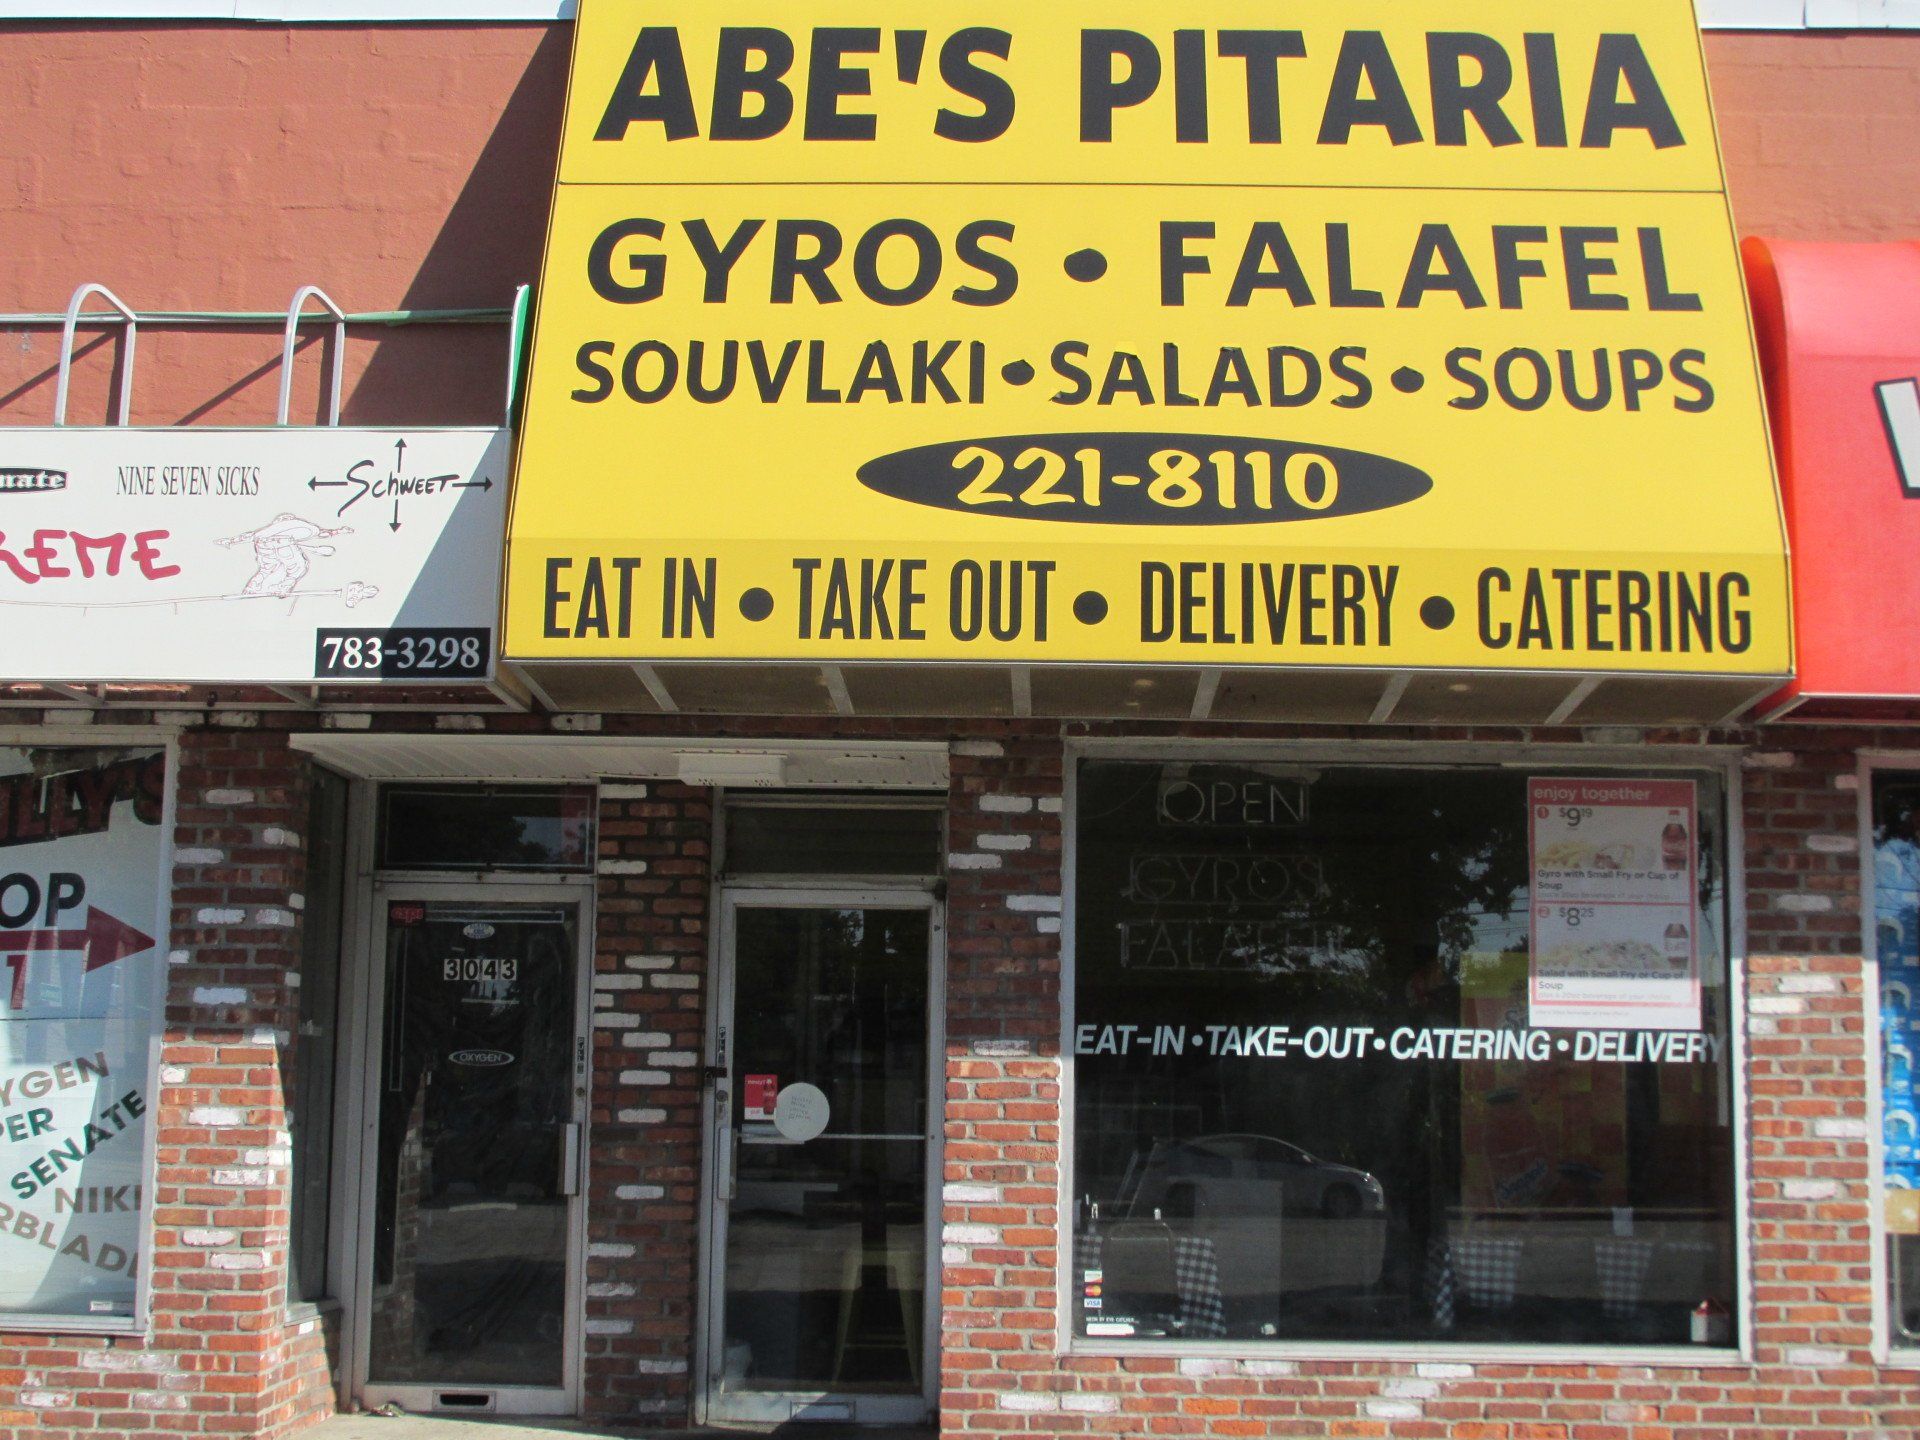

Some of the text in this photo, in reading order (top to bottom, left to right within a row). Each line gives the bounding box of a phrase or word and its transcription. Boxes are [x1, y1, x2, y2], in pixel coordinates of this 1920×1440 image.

[593, 26, 1685, 148] ABE'S PITARIA
[587, 217, 1703, 311] GYROS FALAFEL
[571, 339, 1714, 412] SOUVLAKI SALADS SOUPS
[116, 466, 261, 496] NINE SEVEN SICKS
[952, 446, 1338, 510] 221-8110
[544, 557, 1751, 654] EAT IN TAKE OUT DELIVERY CATERING
[322, 635, 481, 671] 783-3298
[1162, 780, 1305, 823] OPEN
[1534, 786, 1651, 800] enjoy together
[1135, 857, 1322, 901] GYROS
[1537, 881, 1562, 890] Soup
[1538, 870, 1561, 880] Gyro
[1564, 870, 1585, 879] with
[1587, 870, 1613, 879] Small
[1616, 871, 1631, 880] Fry
[1647, 871, 1667, 881] Cup
[444, 959, 517, 980] 3043
[1538, 969, 1565, 978] Salad
[1567, 970, 1588, 978] with
[1591, 970, 1617, 978] Small
[1620, 970, 1635, 980] Fry
[1651, 971, 1671, 980] Cup
[1538, 981, 1563, 991] Soup
[460, 1052, 501, 1063] OXYGEN
[1075, 1024, 1724, 1063] EAT-IN TAKE-OUT CATERING DELIVERY
[0, 1107, 58, 1143] ER
[10, 1089, 147, 1200] SENATE
[1085, 1300, 1101, 1308] VISA
